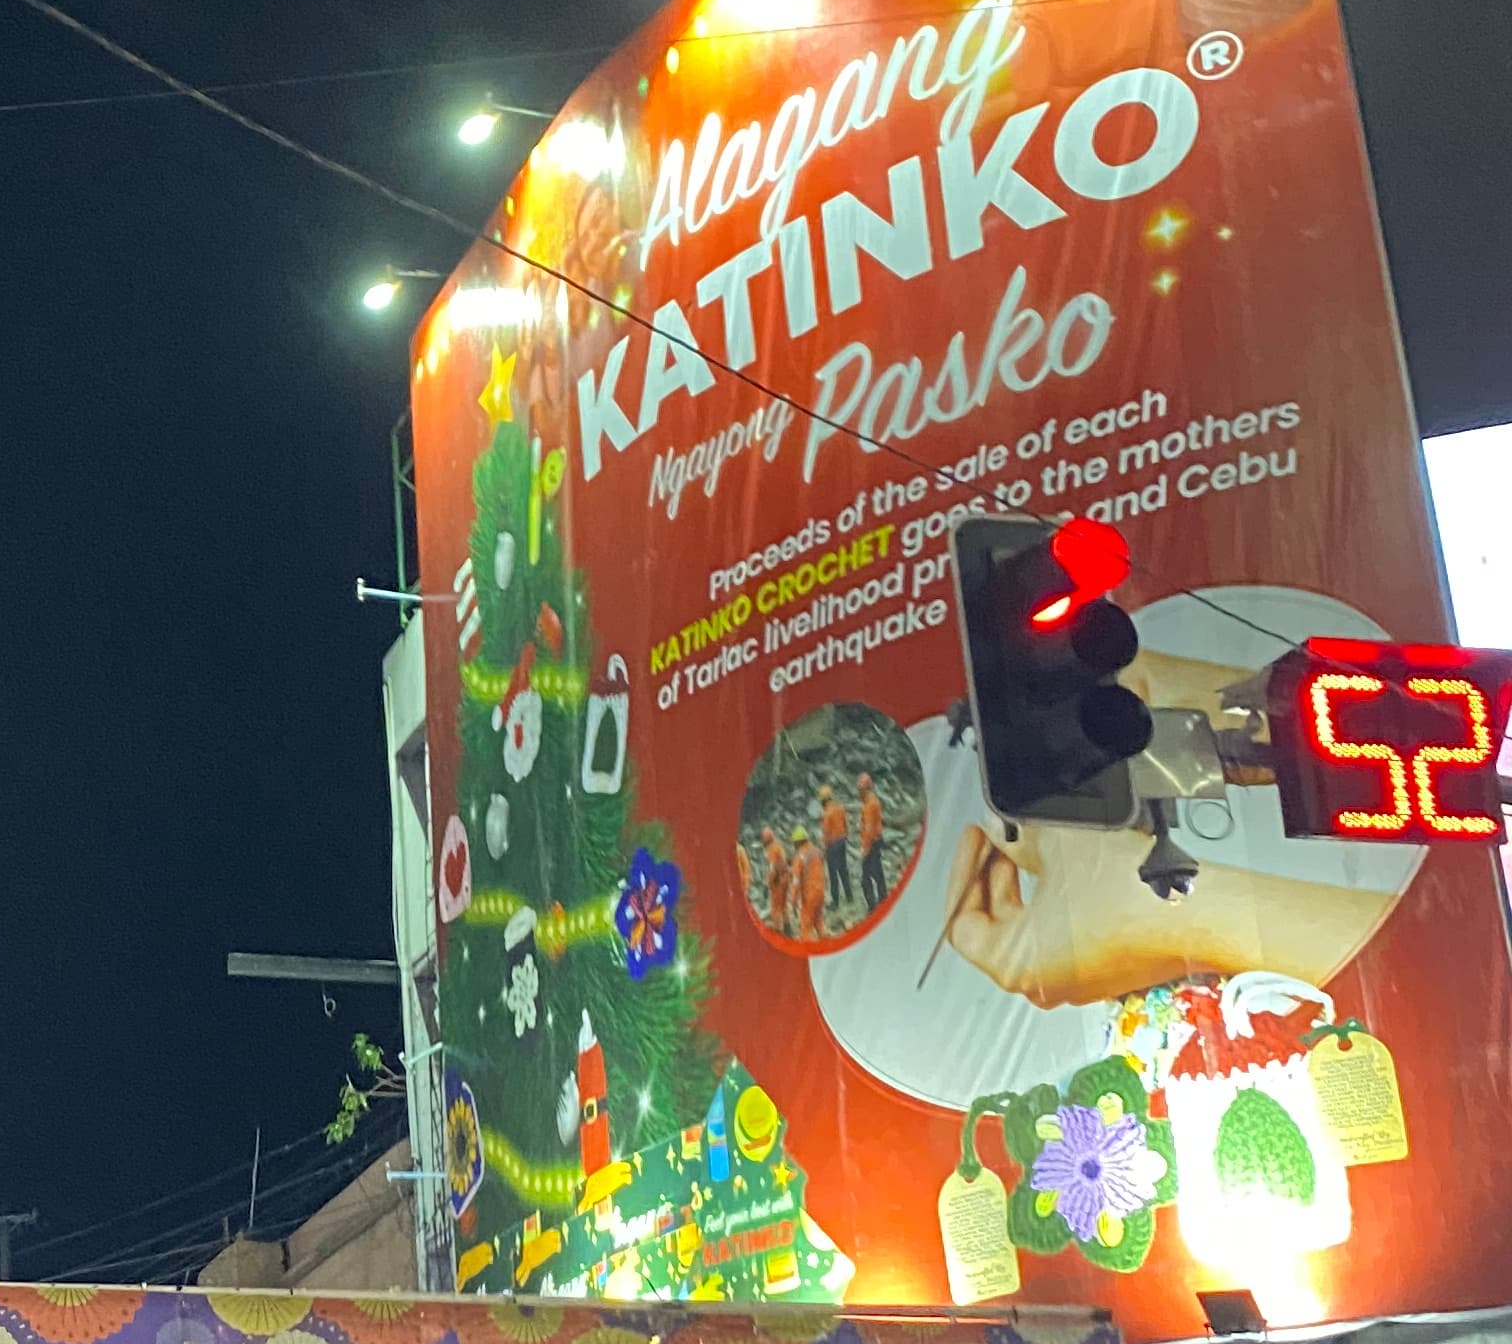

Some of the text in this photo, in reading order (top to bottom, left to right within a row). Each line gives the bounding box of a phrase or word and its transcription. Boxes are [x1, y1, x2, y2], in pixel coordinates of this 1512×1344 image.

[576, 66, 1200, 483] KATINKO
[649, 264, 1117, 521] Ngayong Pasko
[649, 594, 752, 676] KATINKO
[755, 523, 896, 614] CROCHET
[993, 478, 1032, 513] to
[1040, 455, 1109, 497] the
[1118, 401, 1301, 475] mothers
[657, 671, 681, 711] of
[764, 561, 906, 654] livelihood
[1086, 474, 1169, 524] and
[1177, 447, 1299, 499] Cebu
[709, 389, 1169, 601] Proceeds of the sale of each
[768, 597, 949, 694] earthquake
[1306, 670, 1499, 837] 52
